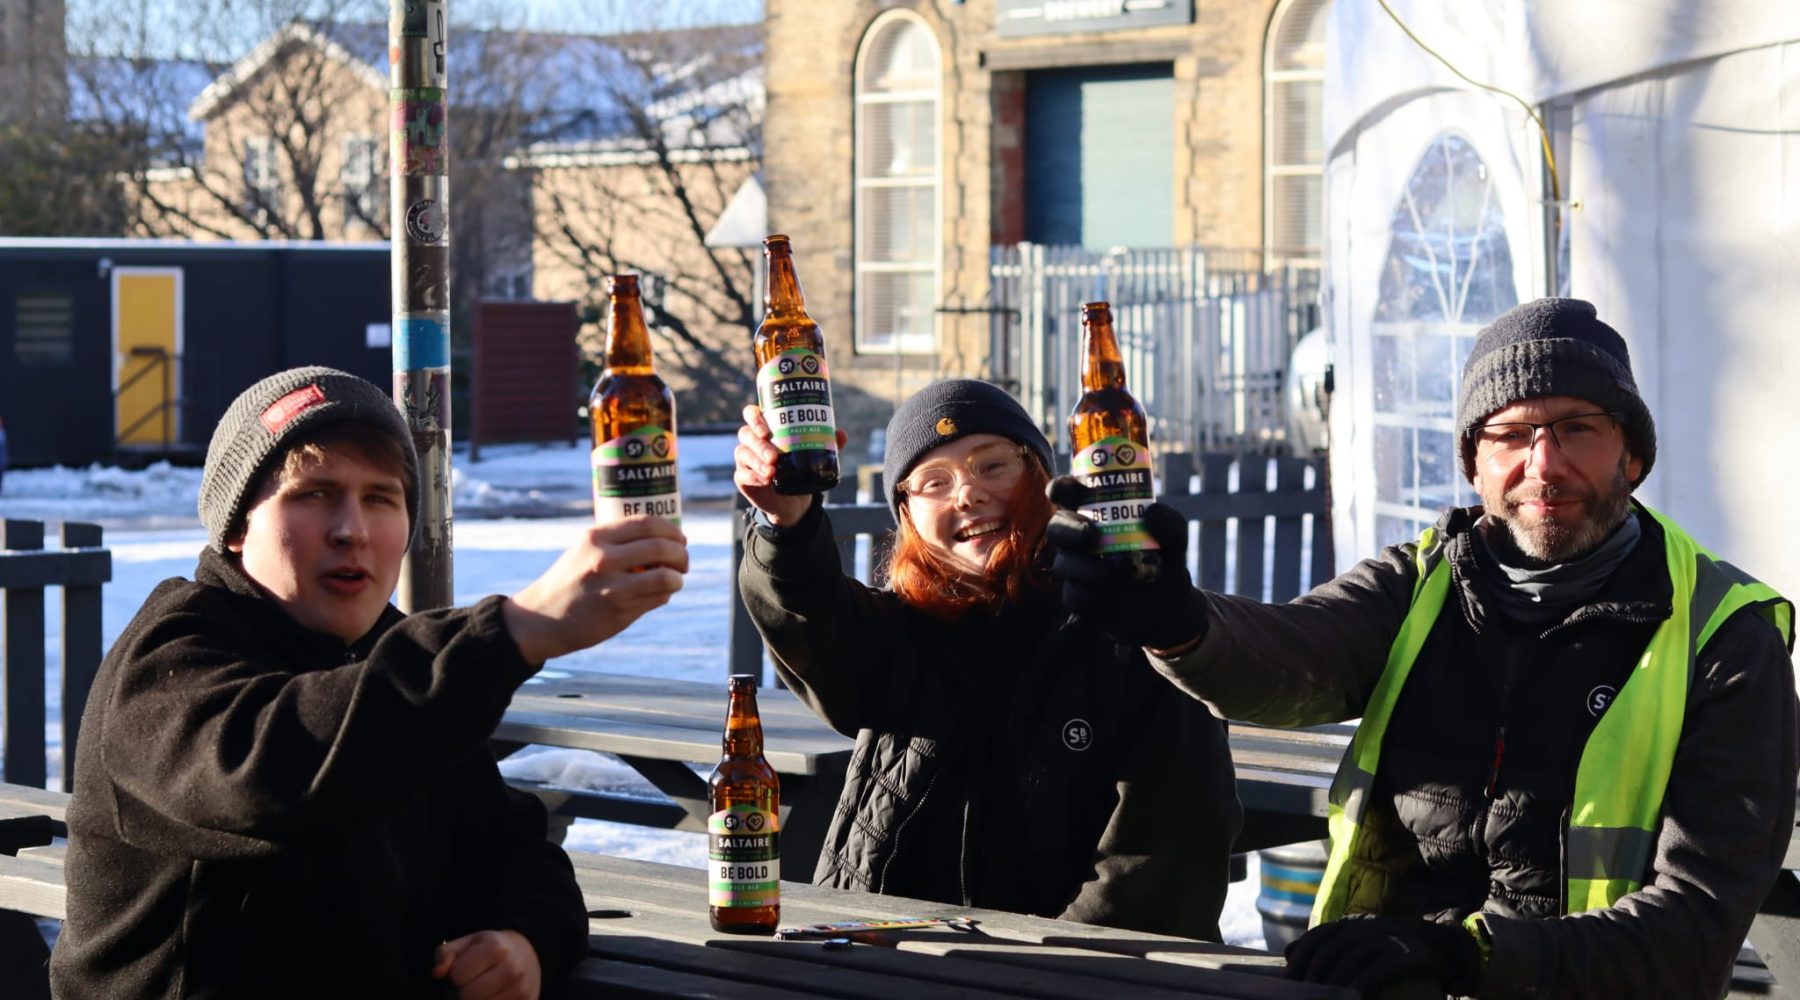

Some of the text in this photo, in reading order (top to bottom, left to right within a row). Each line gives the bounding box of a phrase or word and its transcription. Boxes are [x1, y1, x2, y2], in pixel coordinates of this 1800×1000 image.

[773, 380, 827, 395] SALTAIRE
[779, 408, 828, 425] BE BOLD
[617, 463, 676, 481] SALTAIRE
[1086, 472, 1144, 488] SALTAIRE
[646, 499, 677, 516] BOLD
[1091, 504, 1145, 523] BE BOLD
[718, 837, 771, 848] SALTAIRE
[720, 865, 769, 880] BE BOLD
